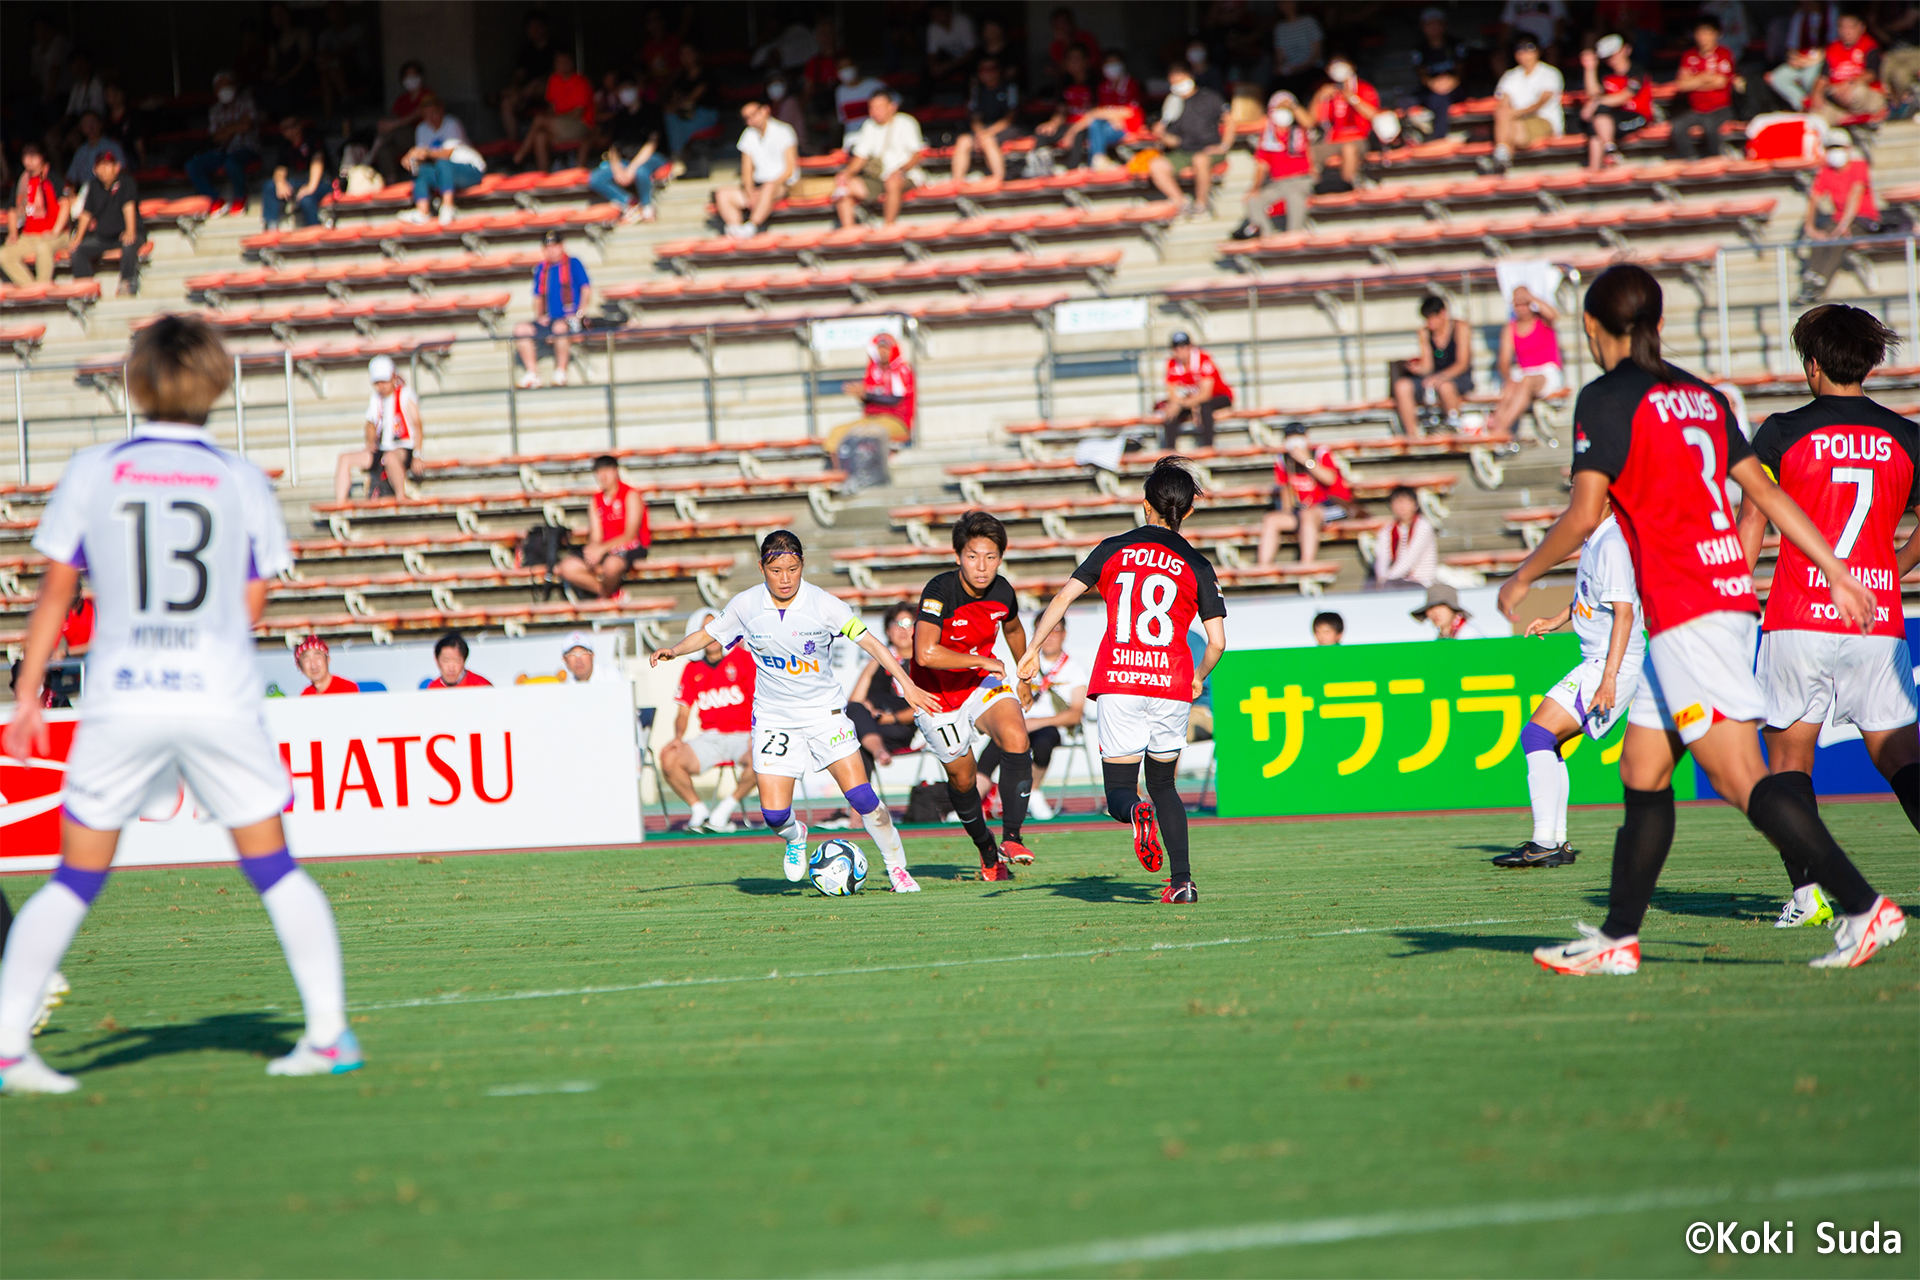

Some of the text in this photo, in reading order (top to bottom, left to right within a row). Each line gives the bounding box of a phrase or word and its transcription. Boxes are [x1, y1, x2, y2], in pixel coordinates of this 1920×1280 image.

[1649, 391, 1718, 423] POLUS
[1811, 434, 1893, 462] POLUS
[1683, 426, 1731, 531] 3
[1831, 467, 1875, 560] 7
[119, 500, 213, 613] 13
[1121, 548, 1184, 576] POLUS
[1712, 573, 1757, 597] TOP
[1807, 566, 1894, 591] TAHASHI
[1115, 572, 1178, 647] 18
[1810, 603, 1889, 623] TON
[1112, 648, 1169, 668] SHIBATA
[1107, 671, 1172, 687] TOPPAN
[937, 723, 960, 747] 11
[1239, 674, 1623, 779] サランラ
[761, 729, 790, 757] 23
